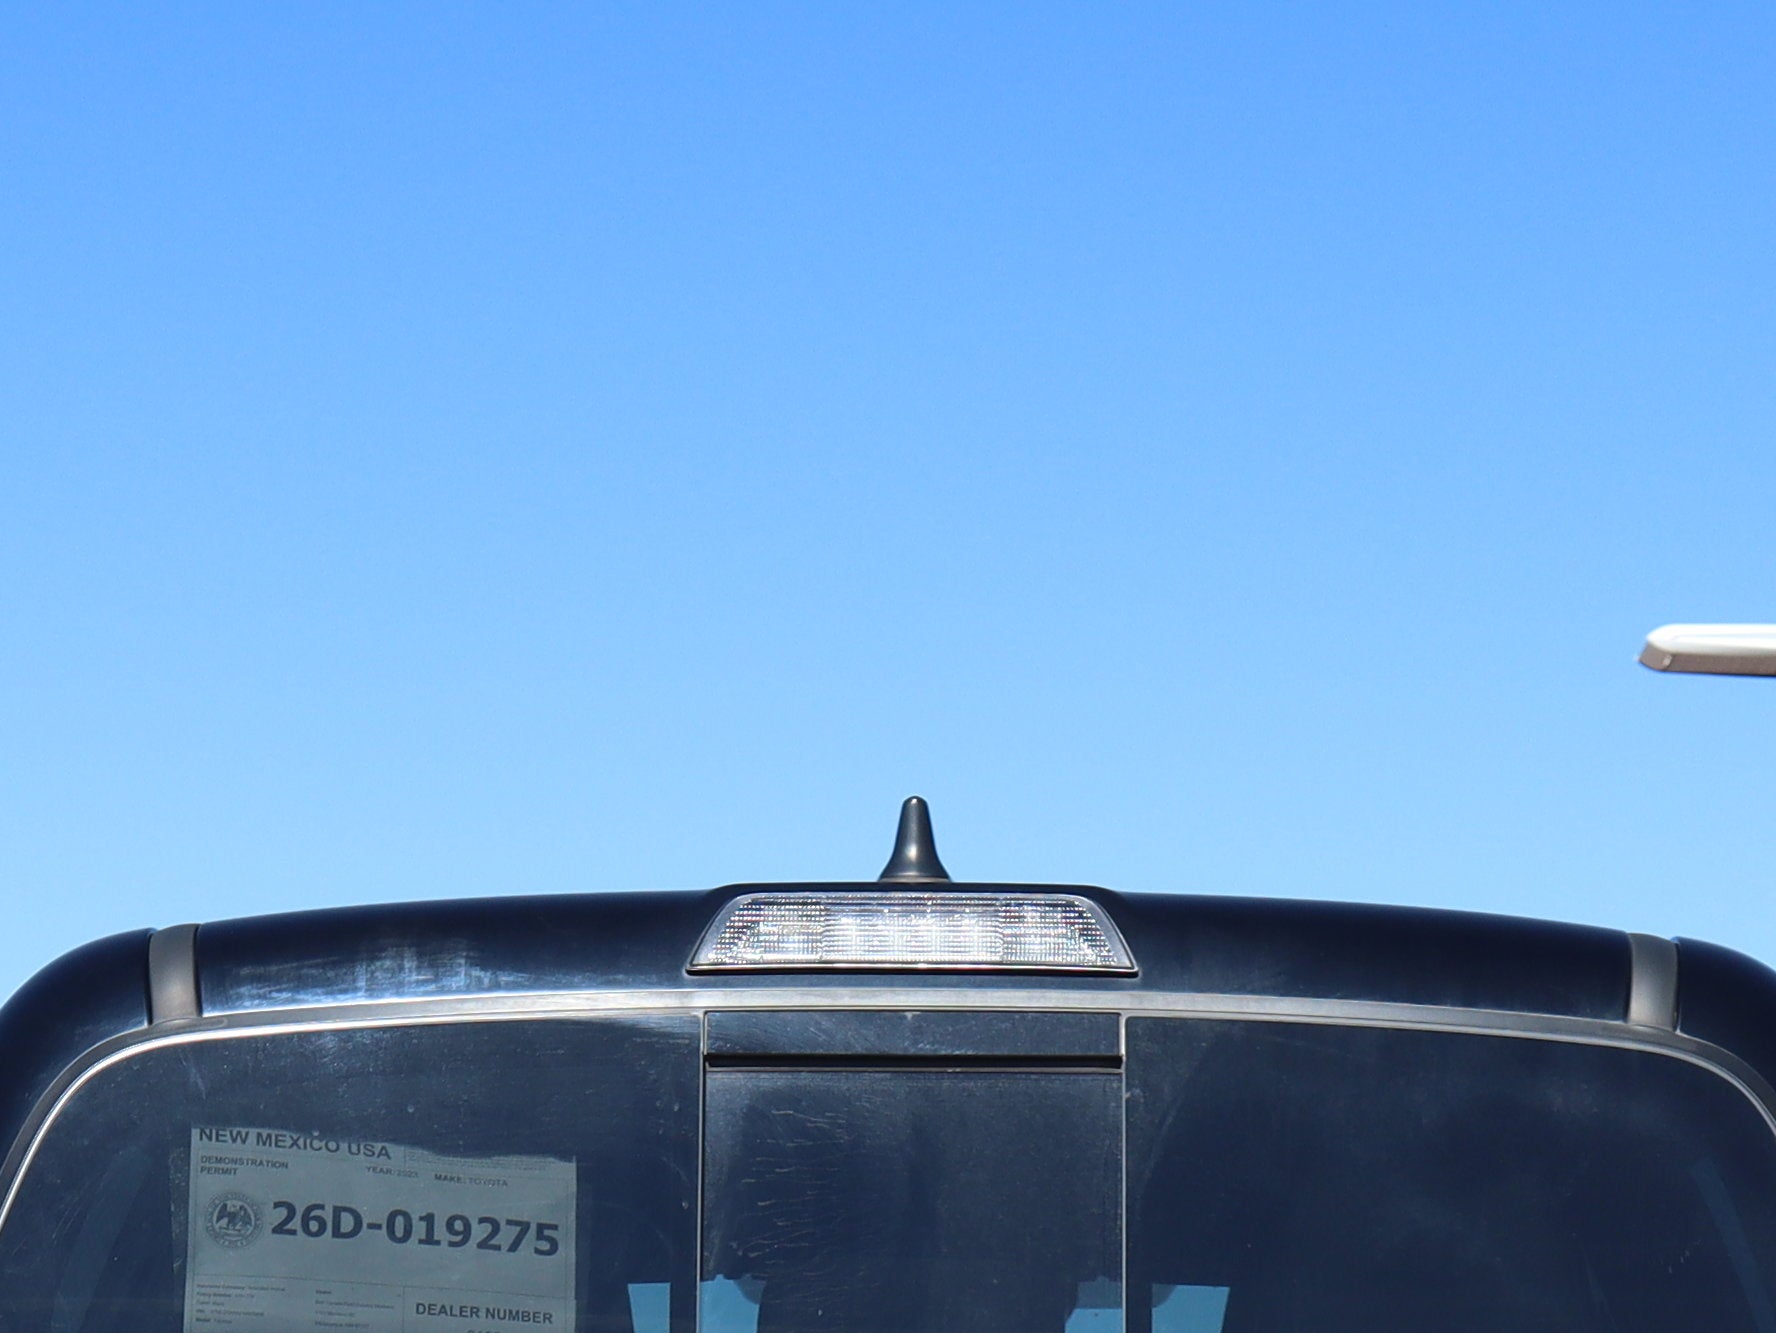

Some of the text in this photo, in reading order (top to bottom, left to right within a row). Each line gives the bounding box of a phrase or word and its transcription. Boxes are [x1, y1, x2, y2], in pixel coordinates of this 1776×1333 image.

[199, 1128, 392, 1160] NEW MEXICO USA
[200, 1155, 289, 1169] DEMONSTRATION
[200, 1165, 238, 1175] PERMIT
[468, 1177, 508, 1187] TOYOTA
[271, 1201, 560, 1257] 26D-019275
[415, 1302, 553, 1324] DEALER NUMBER
